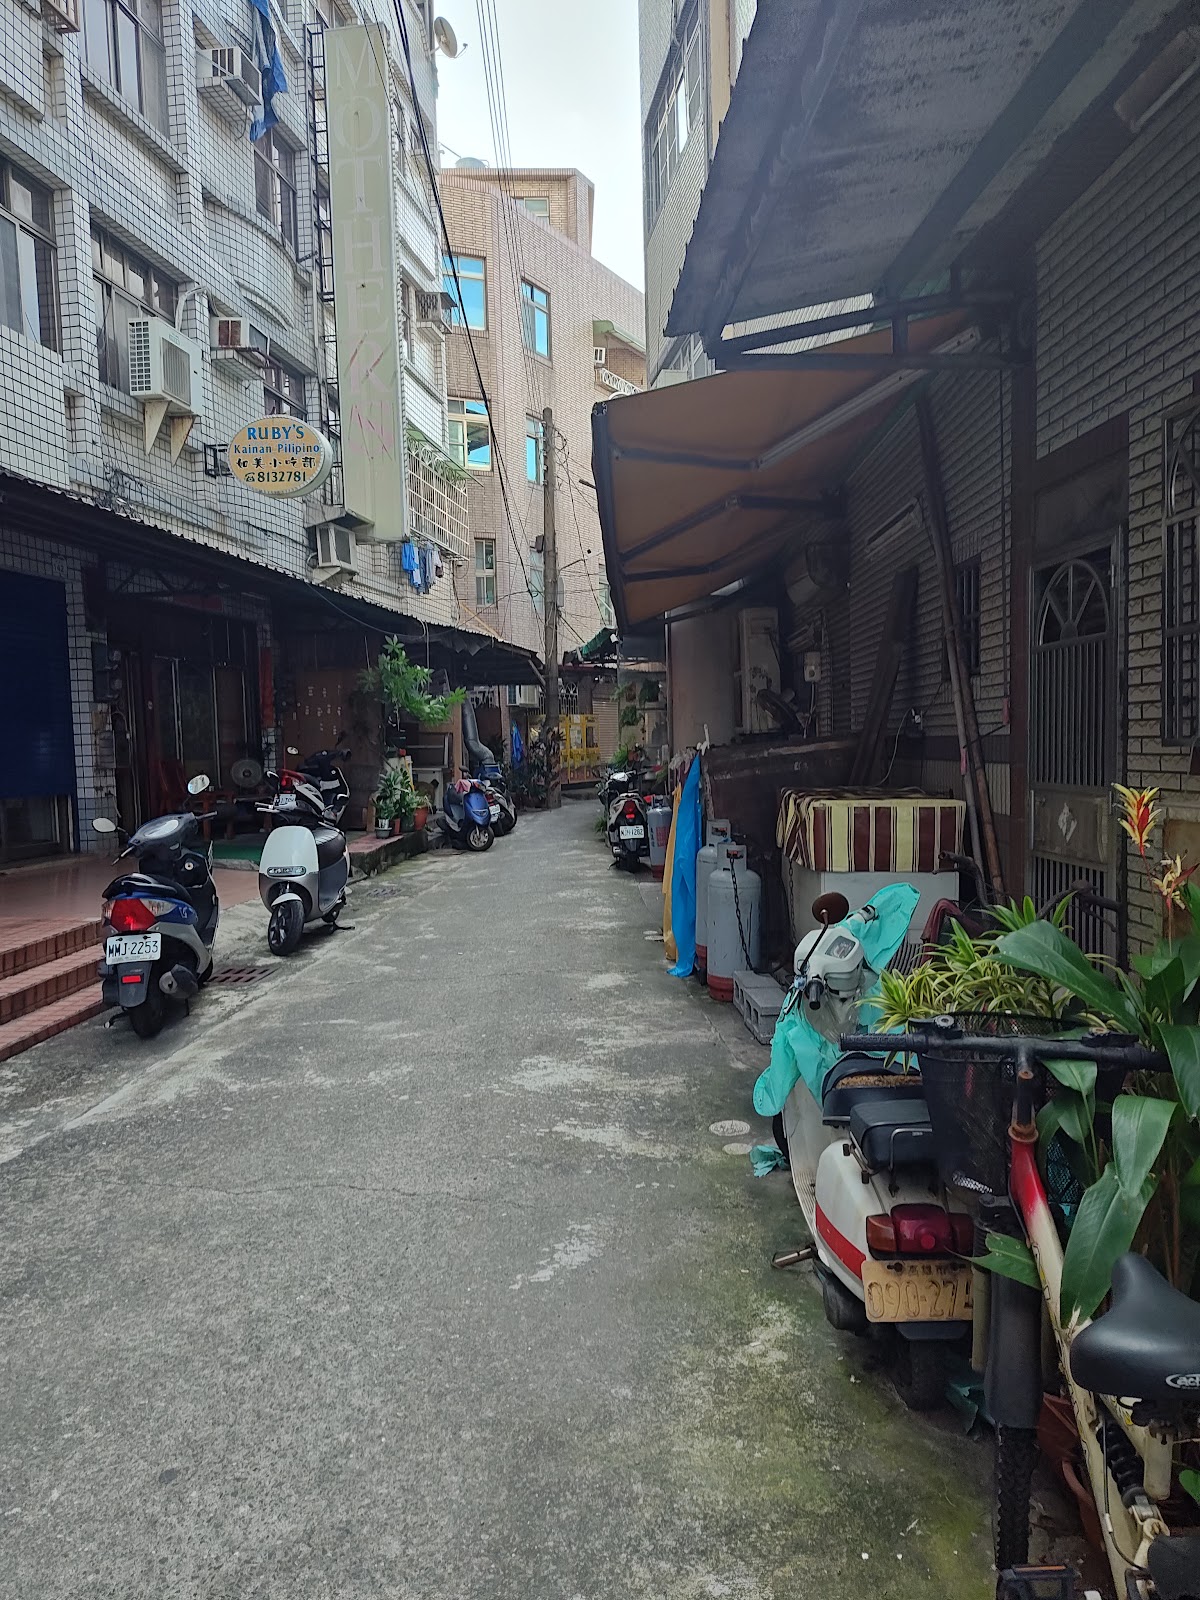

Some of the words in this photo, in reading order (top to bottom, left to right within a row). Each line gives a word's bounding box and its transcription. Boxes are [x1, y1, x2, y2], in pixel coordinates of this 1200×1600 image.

[247, 424, 305, 440] RUBY'S
[234, 444, 272, 454] Kainan
[278, 443, 320, 455] Pilipino
[236, 456, 316, 469] 如美小吃部
[257, 471, 307, 483] 8132781
